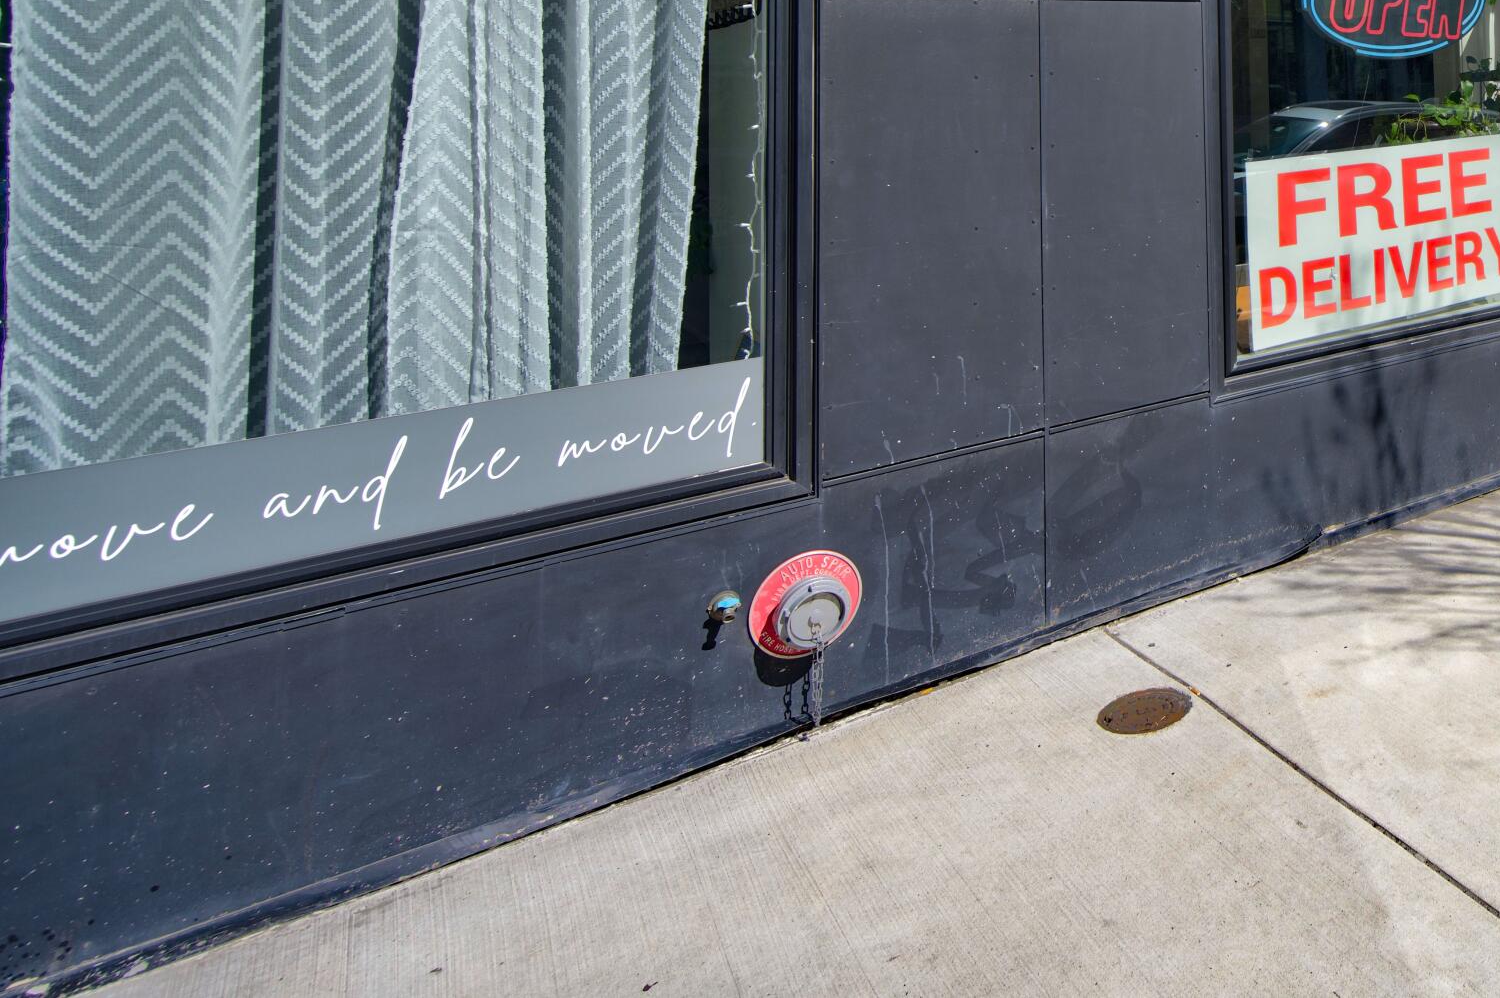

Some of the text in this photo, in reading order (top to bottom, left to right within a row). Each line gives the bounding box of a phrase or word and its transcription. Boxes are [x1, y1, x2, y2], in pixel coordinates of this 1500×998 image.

[1276, 147, 1493, 248] FREE
[262, 435, 408, 530] and
[439, 417, 522, 500] be
[820, 556, 851, 579] SPKR
[760, 631, 775, 647] FIRE
